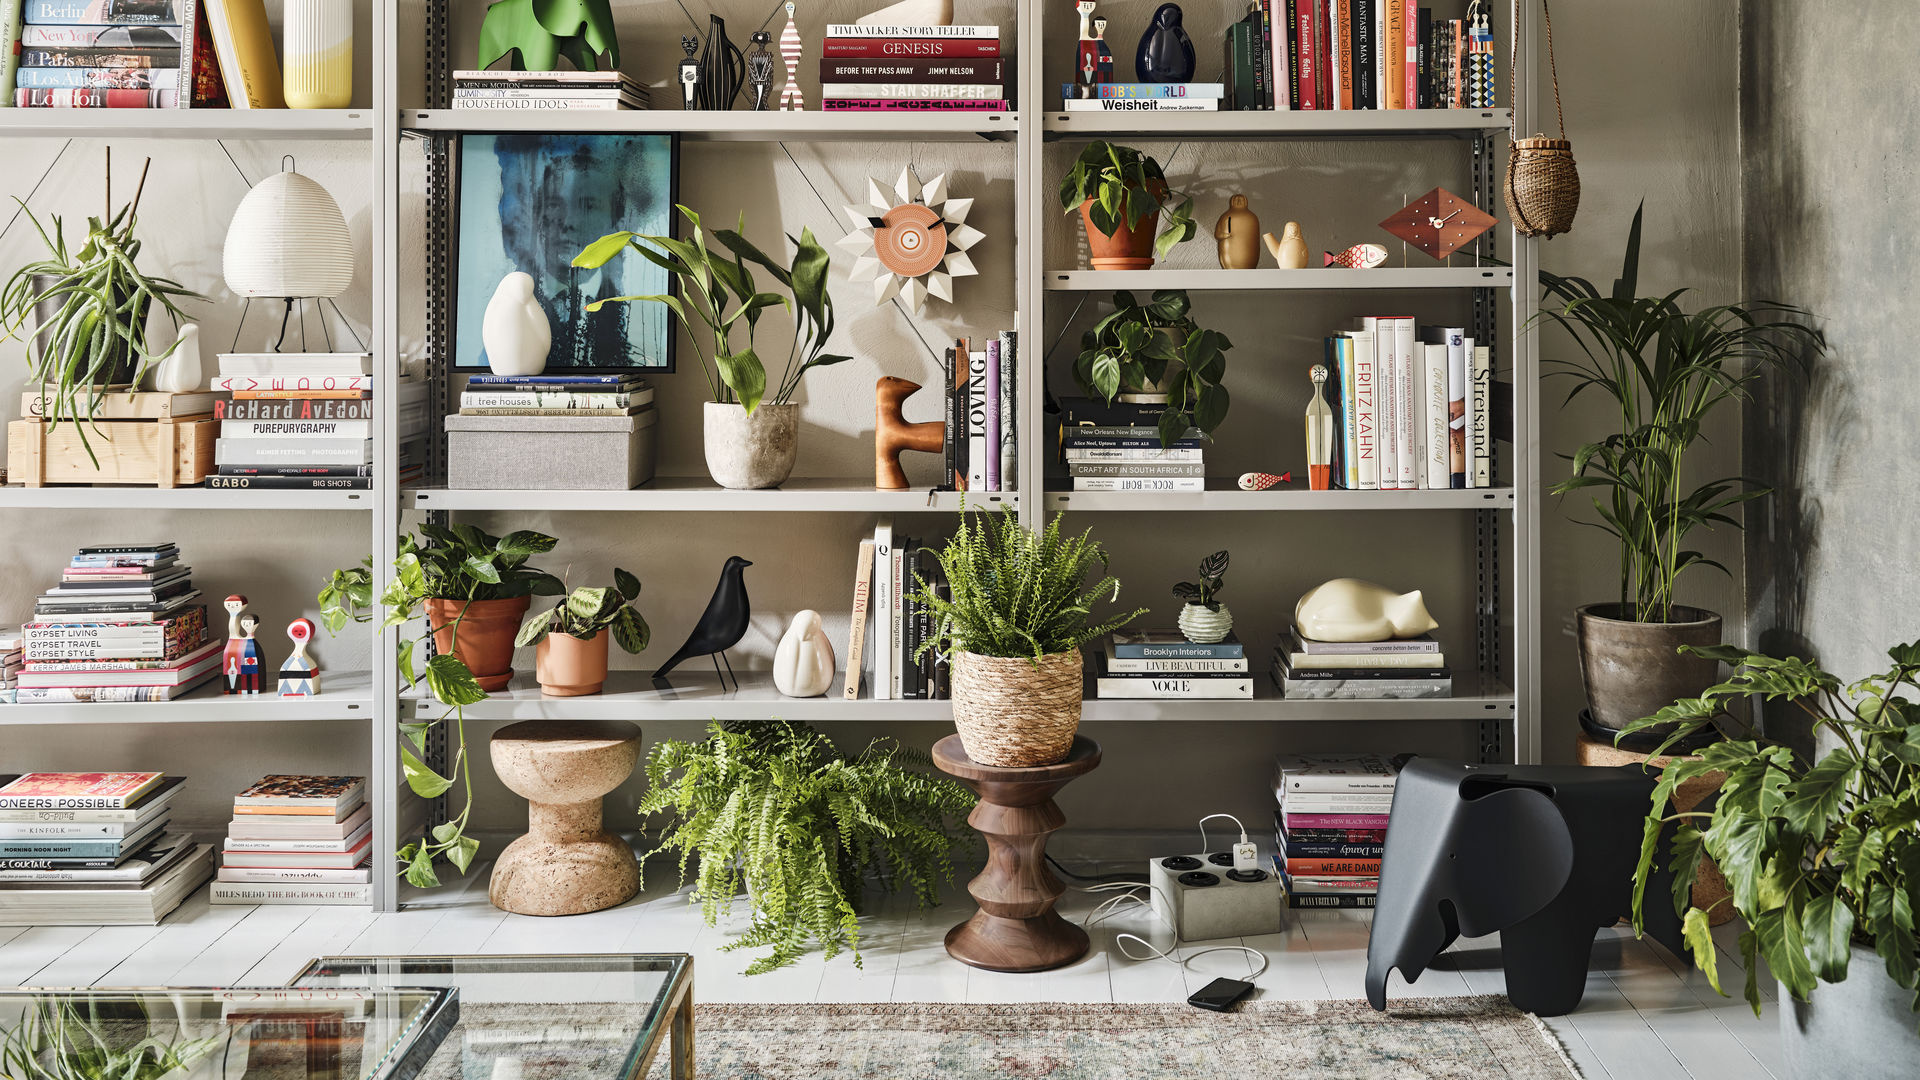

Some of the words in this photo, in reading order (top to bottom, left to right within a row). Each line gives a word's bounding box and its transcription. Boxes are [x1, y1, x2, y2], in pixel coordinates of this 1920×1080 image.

[40, 4, 86, 18] Berlin
[1391, 0, 1400, 33] GRACE
[1340, 0, 1350, 49] ean-Michel
[38, 29, 65, 42] New
[833, 26, 854, 34] TIM
[854, 26, 899, 35] WALKER
[902, 27, 934, 35] STORY
[936, 27, 975, 35] TELLER
[1302, 14, 1310, 54] Fashionable
[184, 24, 192, 55] DAGMAR
[883, 43, 943, 54] GENESIS
[39, 52, 76, 66] Paris
[1302, 58, 1310, 78] Selby
[1341, 50, 1351, 90] Basquiat
[33, 72, 59, 86] Los
[182, 72, 190, 96] TAUBE
[881, 86, 916, 97] STAN
[922, 86, 985, 98] SHAFFER
[1103, 86, 1136, 97] BOB'S
[32, 90, 101, 106] London
[457, 100, 530, 108] HOUSEHOLD
[534, 100, 568, 109] IDOLS
[1102, 100, 1158, 110] Weisheit
[221, 377, 361, 391] AVEDON
[1358, 362, 1372, 407] FRITZ
[479, 397, 496, 405] tree
[500, 395, 531, 406] houses
[971, 359, 985, 438] LOVING
[1474, 368, 1489, 457] Streisand
[254, 424, 336, 434] PUREPURYGRAPHY
[1359, 414, 1373, 459] KAHN
[211, 479, 250, 488] GABO
[1122, 481, 1142, 489] BOAT
[1153, 481, 1174, 489] ROCK
[854, 581, 868, 613] KILIM
[30, 630, 65, 638] GYPSET
[68, 630, 98, 638] LIVING
[30, 641, 65, 649] GYPSET
[67, 640, 102, 648] TRAVEL
[30, 650, 65, 658] GYPSET
[1143, 648, 1178, 657] Brooklyn
[61, 663, 88, 671] JAMES
[90, 662, 133, 670] MARSHALL
[1146, 662, 1168, 670] LIVE
[1171, 662, 1226, 670] BEAUTIFUL
[1152, 681, 1190, 692] VOGUE
[0, 799, 52, 808] ONEERS
[58, 799, 120, 808] POSSIBLE
[39, 812, 75, 820] Build-On
[1340, 845, 1369, 856] Dandy
[1321, 864, 1334, 872] WE
[1335, 864, 1353, 872] ARE
[338, 891, 357, 899] CHIC
